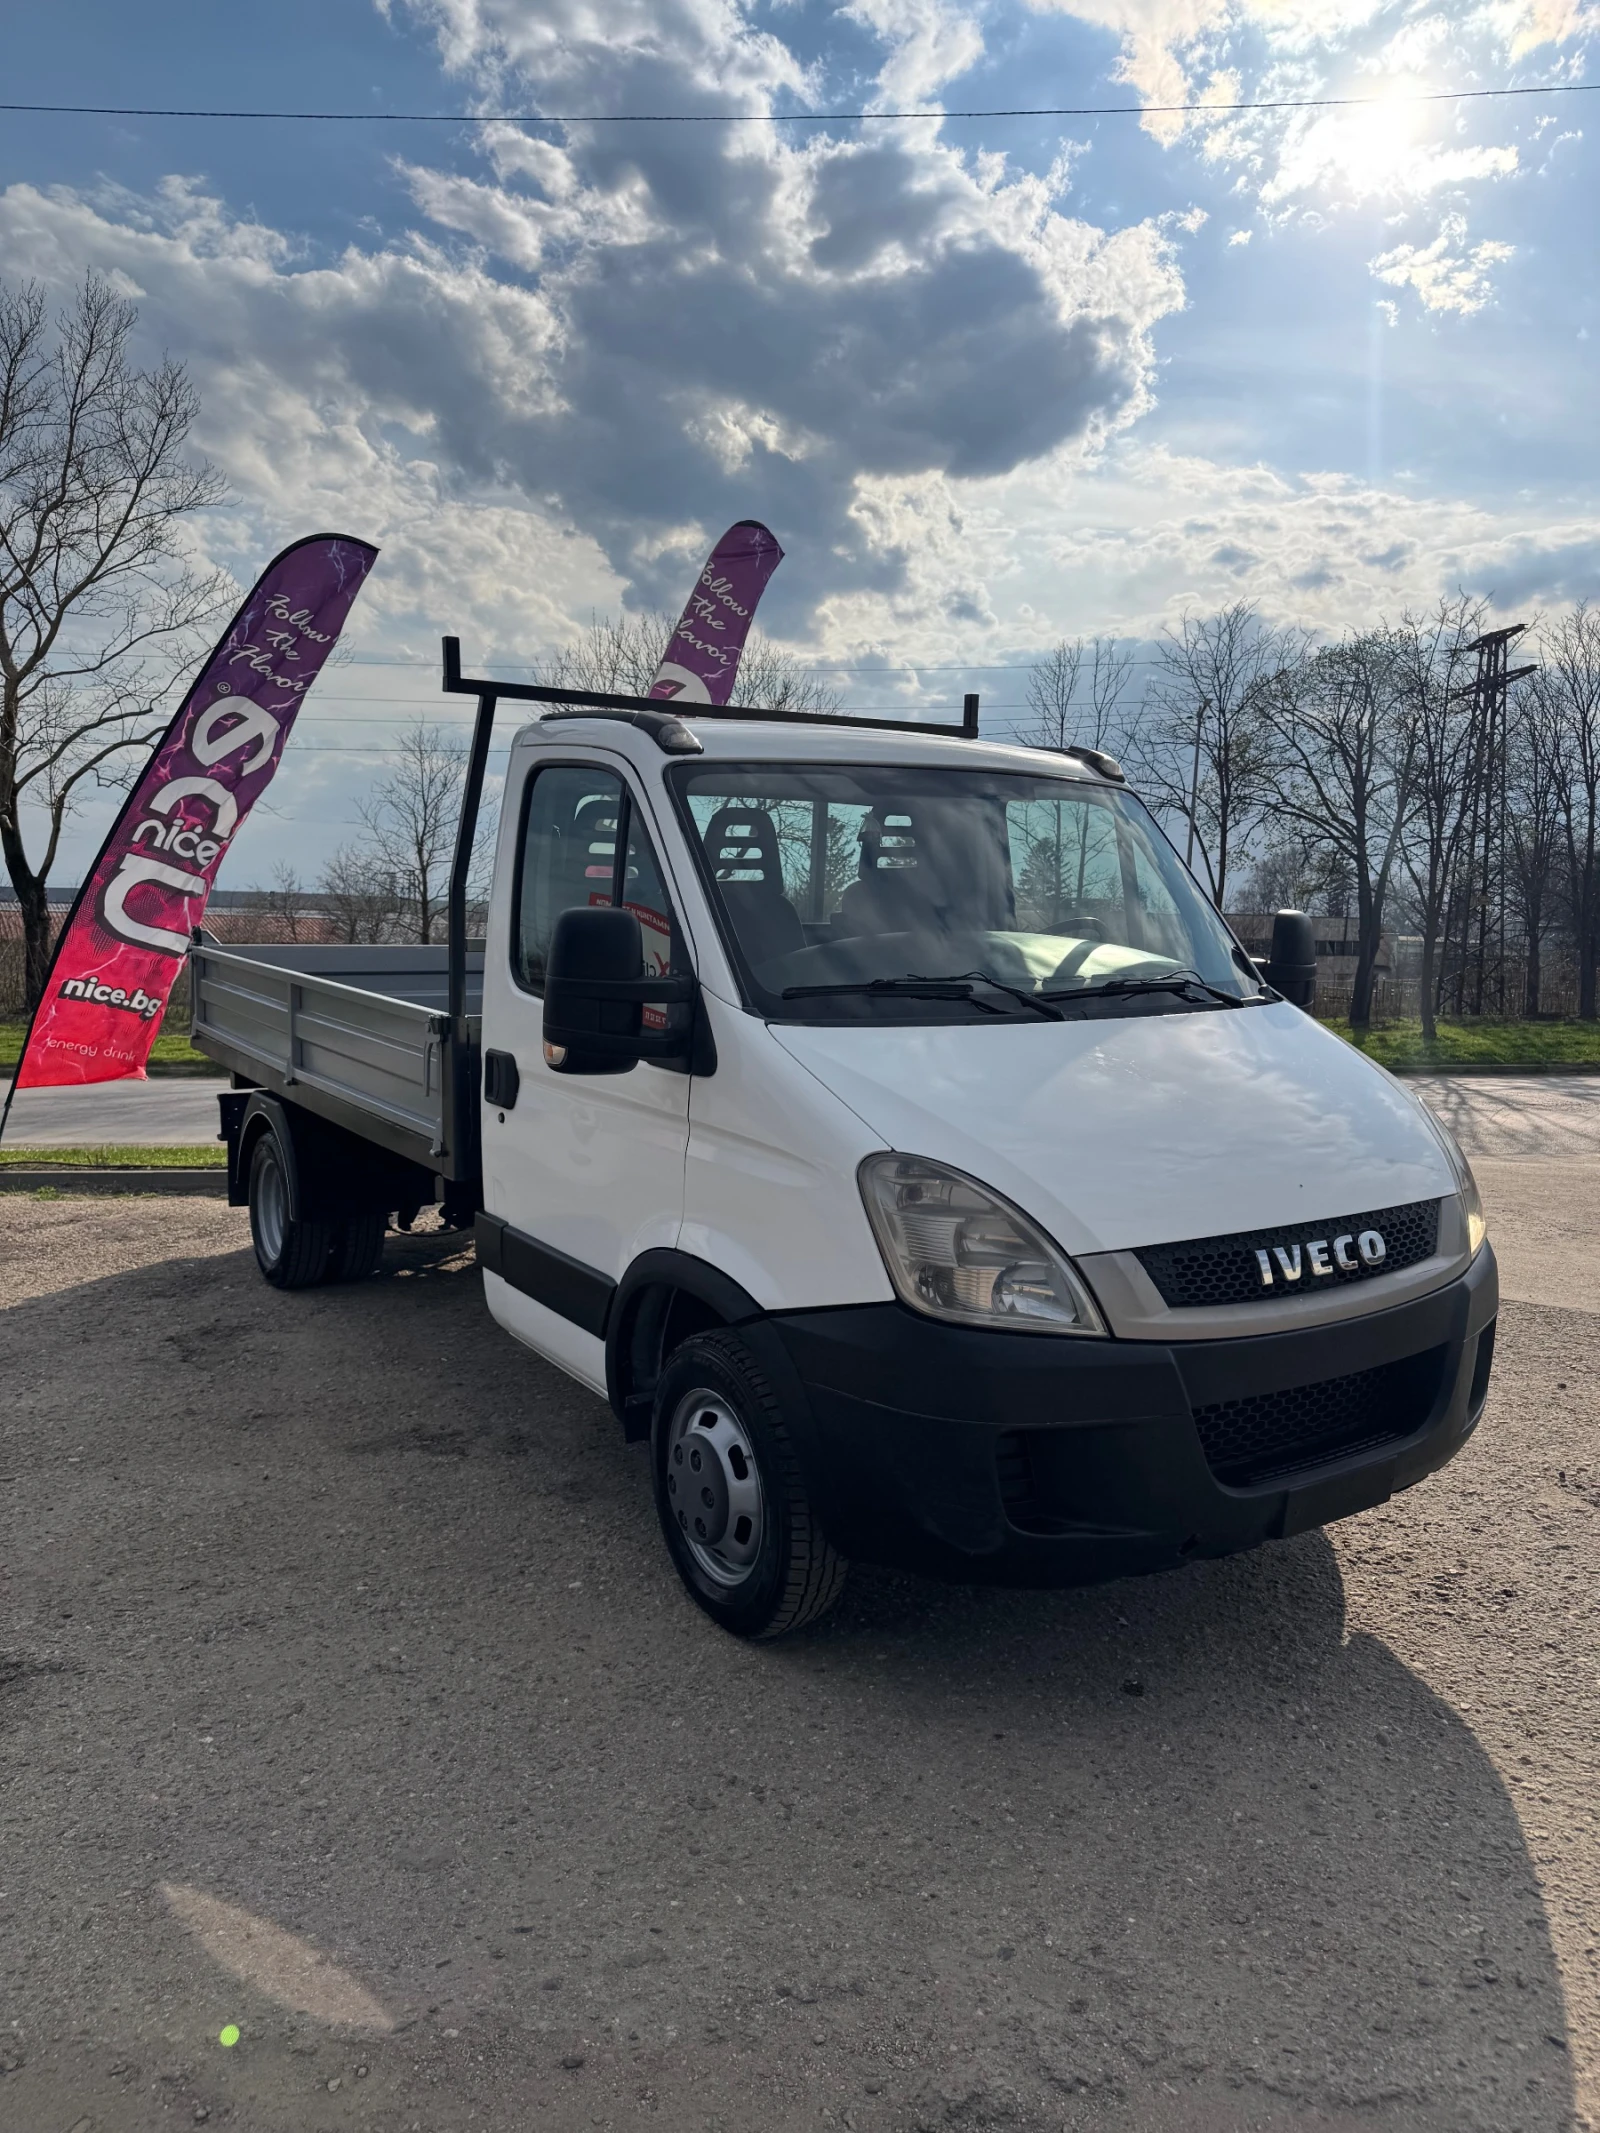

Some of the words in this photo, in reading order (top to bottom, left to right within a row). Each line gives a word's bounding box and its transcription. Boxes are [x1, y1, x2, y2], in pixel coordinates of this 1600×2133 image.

[265, 593, 331, 643] Follow
[693, 594, 727, 630] the
[266, 629, 301, 661] the
[677, 619, 732, 665] lavor
[227, 644, 309, 692] Flavor
[131, 819, 222, 866] nice
[63, 976, 163, 1018] nice.bg
[49, 1038, 98, 1058] energy
[103, 1045, 136, 1062] drink
[1254, 1230, 1387, 1286] IVECO
